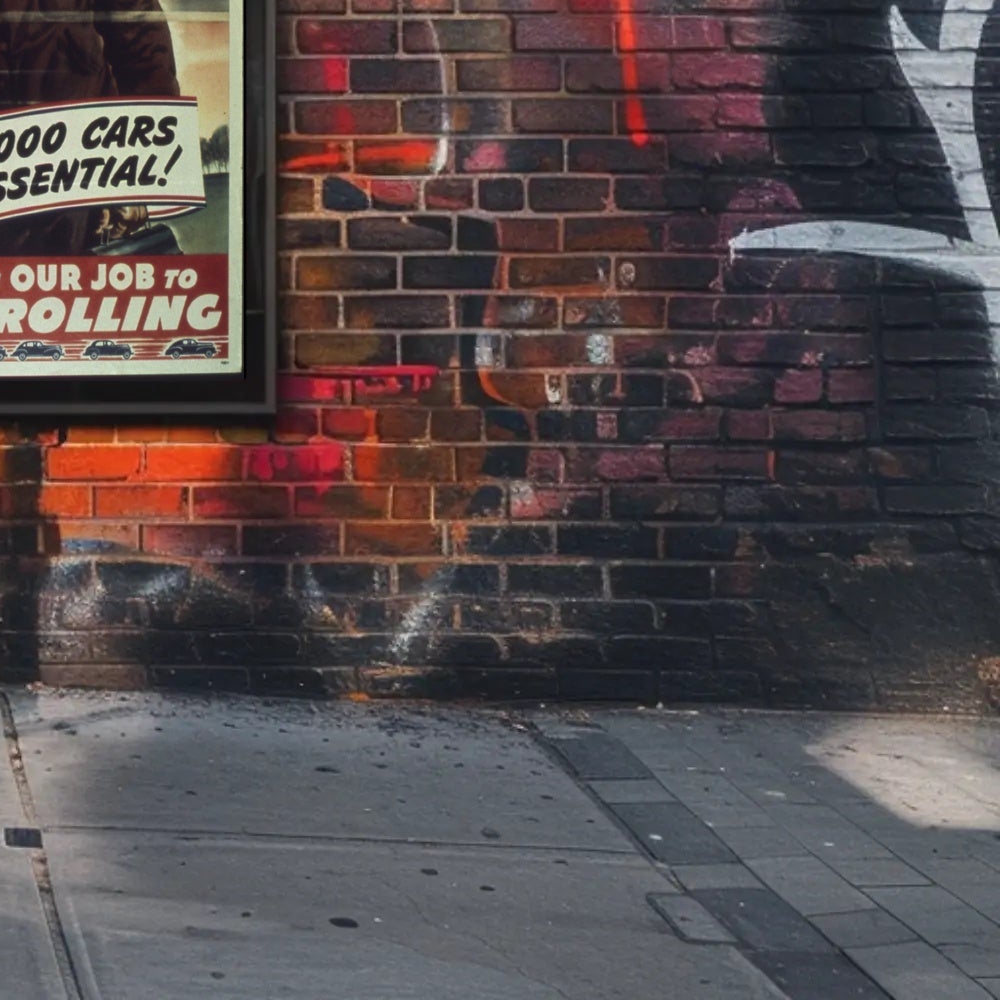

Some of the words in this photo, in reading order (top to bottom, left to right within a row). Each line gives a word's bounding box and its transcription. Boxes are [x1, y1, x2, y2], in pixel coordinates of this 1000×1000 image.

[80, 115, 179, 150] CARS
[9, 264, 84, 291] OUR
[90, 262, 155, 290] JOB
[164, 269, 198, 289] TO
